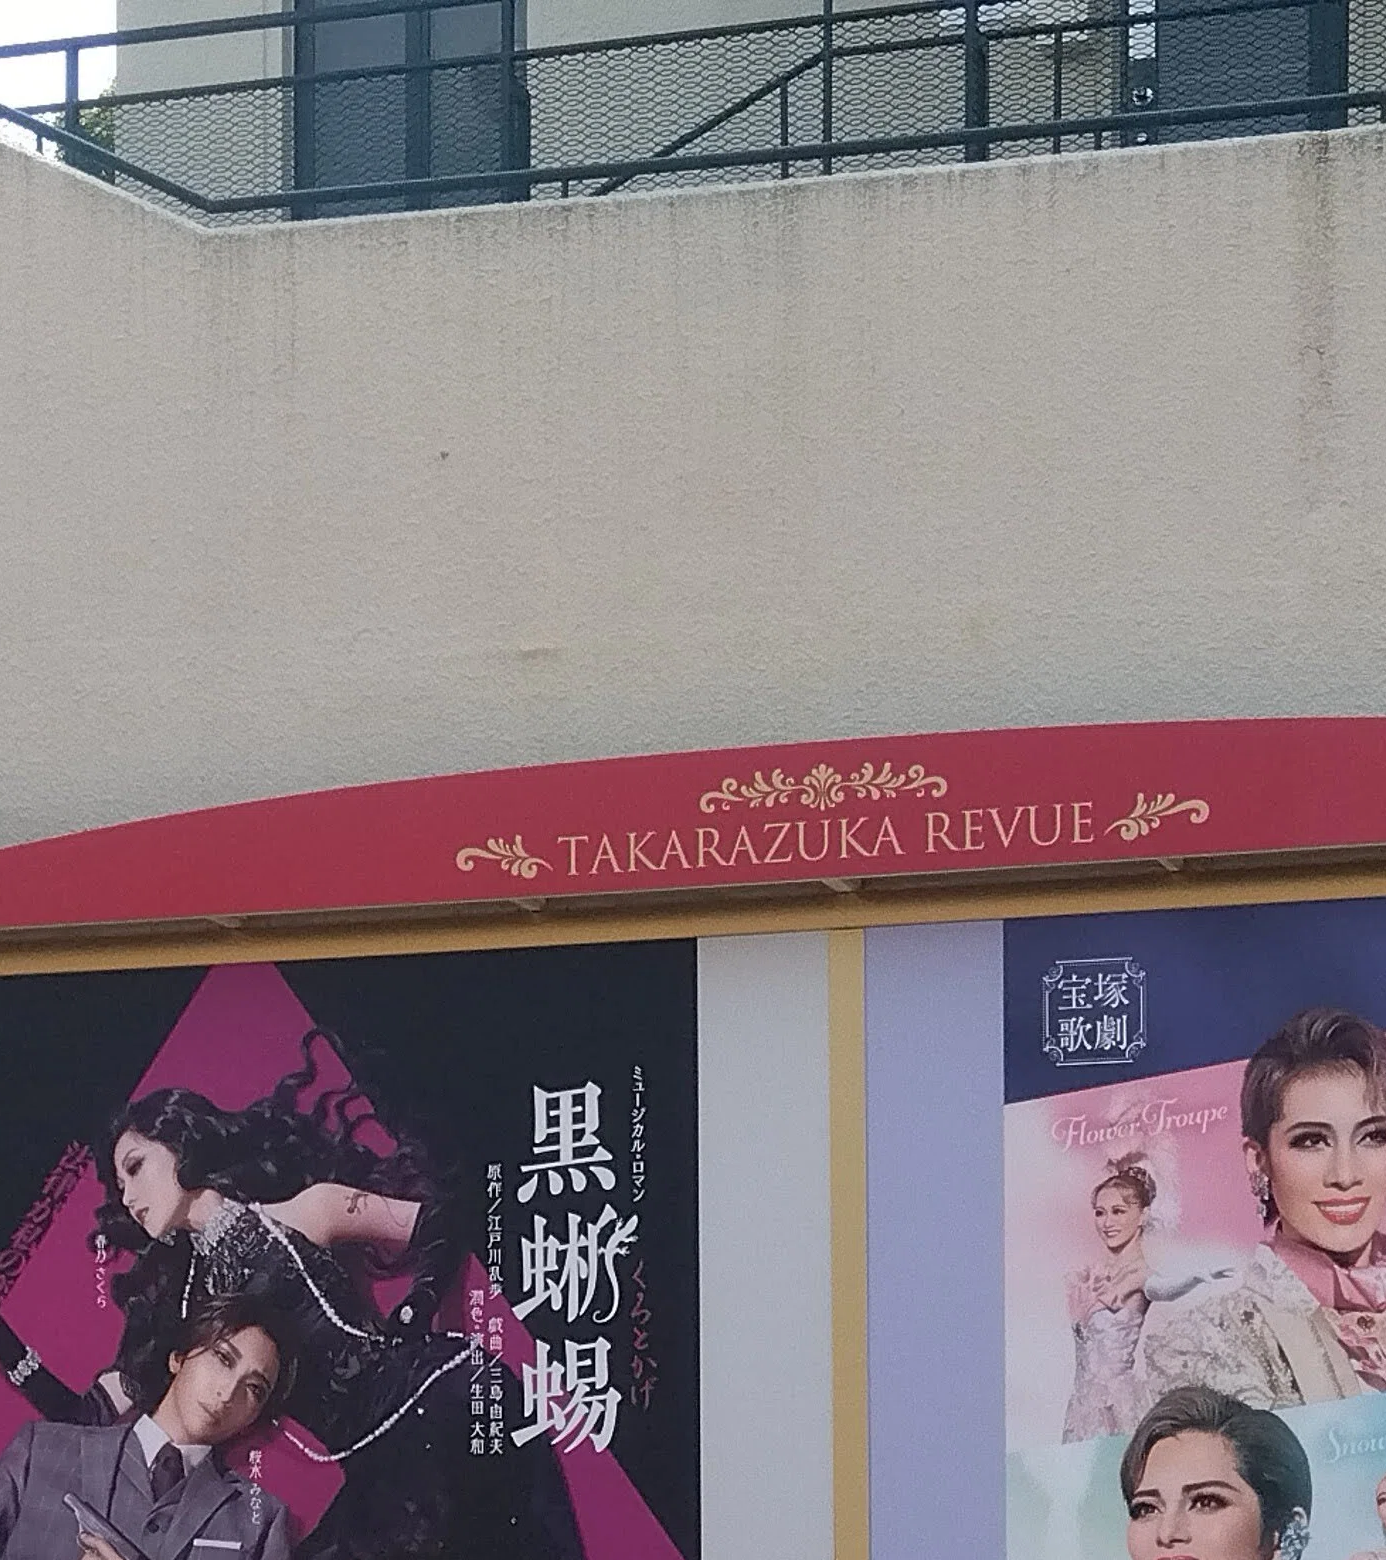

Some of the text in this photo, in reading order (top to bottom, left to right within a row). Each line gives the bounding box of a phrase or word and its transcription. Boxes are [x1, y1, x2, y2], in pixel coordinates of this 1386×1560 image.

[557, 800, 1096, 878] TAKARAZUKA REVUE
[1057, 971, 1130, 1013] 宝塚
[1057, 1015, 1129, 1053] 歌劇
[630, 1065, 646, 1203] ミュージカル・ロマン
[1051, 1098, 1229, 1151] Flower Troupe
[486, 1162, 505, 1301] 原作/江戸川乱歩
[511, 1080, 635, 1455] 黒蜥蜴
[629, 1260, 659, 1412] くろとかげ
[469, 1420, 486, 1456] 大和
